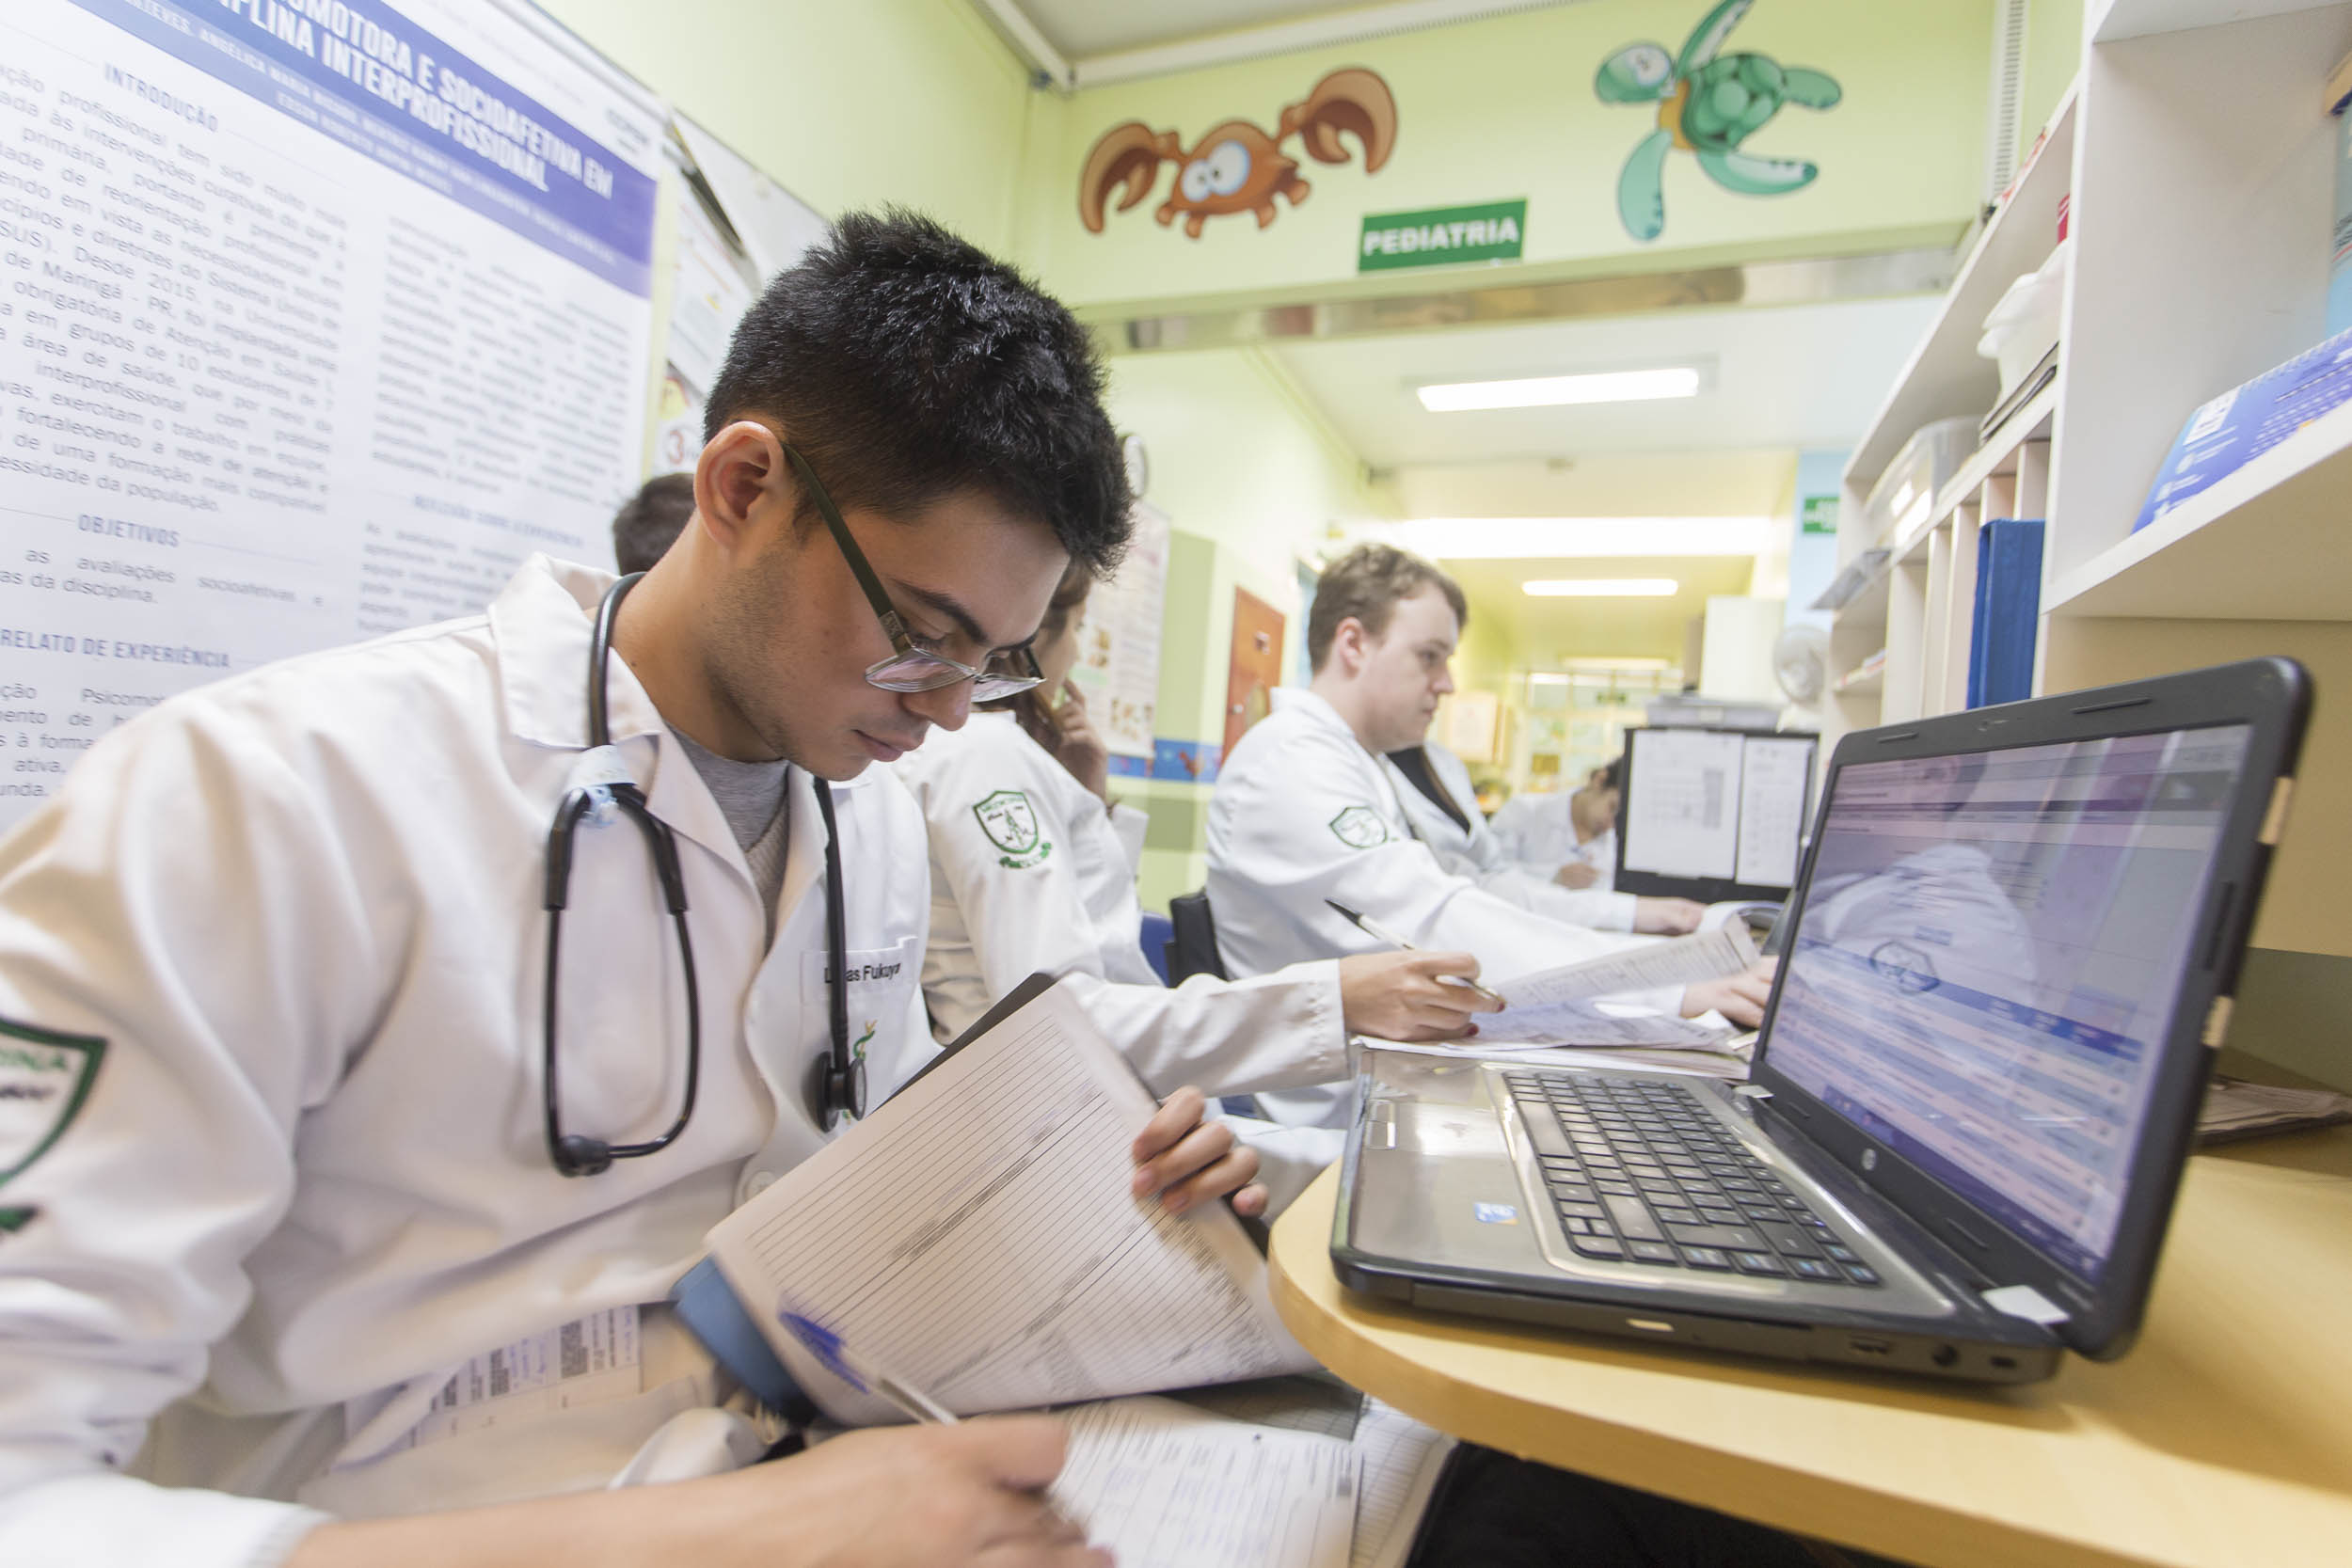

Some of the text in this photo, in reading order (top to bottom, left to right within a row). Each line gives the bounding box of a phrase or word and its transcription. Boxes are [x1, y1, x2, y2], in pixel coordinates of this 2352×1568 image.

[103, 61, 218, 134] INTRODUÇÃO
[320, 32, 549, 193] INTERPROFISSIONAL
[49, 108, 74, 132] às
[83, 126, 197, 186] intervenções
[59, 89, 167, 149] profissional
[177, 142, 210, 167] tem
[417, 53, 437, 91] E
[583, 156, 613, 200] EM
[60, 166, 87, 188] de
[103, 183, 212, 239] reorientação
[60, 193, 92, 216] em
[101, 207, 144, 235] vista
[151, 228, 173, 247] as
[72, 222, 85, 238] e
[91, 228, 173, 272] diretrizes
[1363, 215, 1520, 258] PEDIATRIA
[5, 249, 32, 271] de
[42, 259, 123, 301] Maringá
[74, 245, 136, 281] Desde
[13, 279, 123, 325] obrigatória
[131, 315, 157, 336] de
[23, 330, 69, 358] área
[82, 350, 109, 369] de
[25, 308, 58, 331] em
[68, 322, 136, 355] grupos
[144, 343, 168, 363] de
[35, 360, 187, 415] interprofissional
[50, 391, 145, 428] exercitam
[151, 418, 165, 433] o
[16, 405, 143, 450] fortalecendo
[12, 430, 41, 451] de
[53, 442, 98, 464] uma
[107, 451, 194, 484] formação
[95, 474, 121, 493] da
[77, 514, 180, 548] OBJETIVOS
[24, 547, 52, 565] as
[75, 556, 178, 585] avaliações
[29, 572, 56, 591] da
[62, 577, 159, 605] disciplina.
[0, 627, 230, 669] RELATO DE EXPERIÊNCIA
[68, 712, 95, 728] de
[13, 755, 68, 775] ativa.
